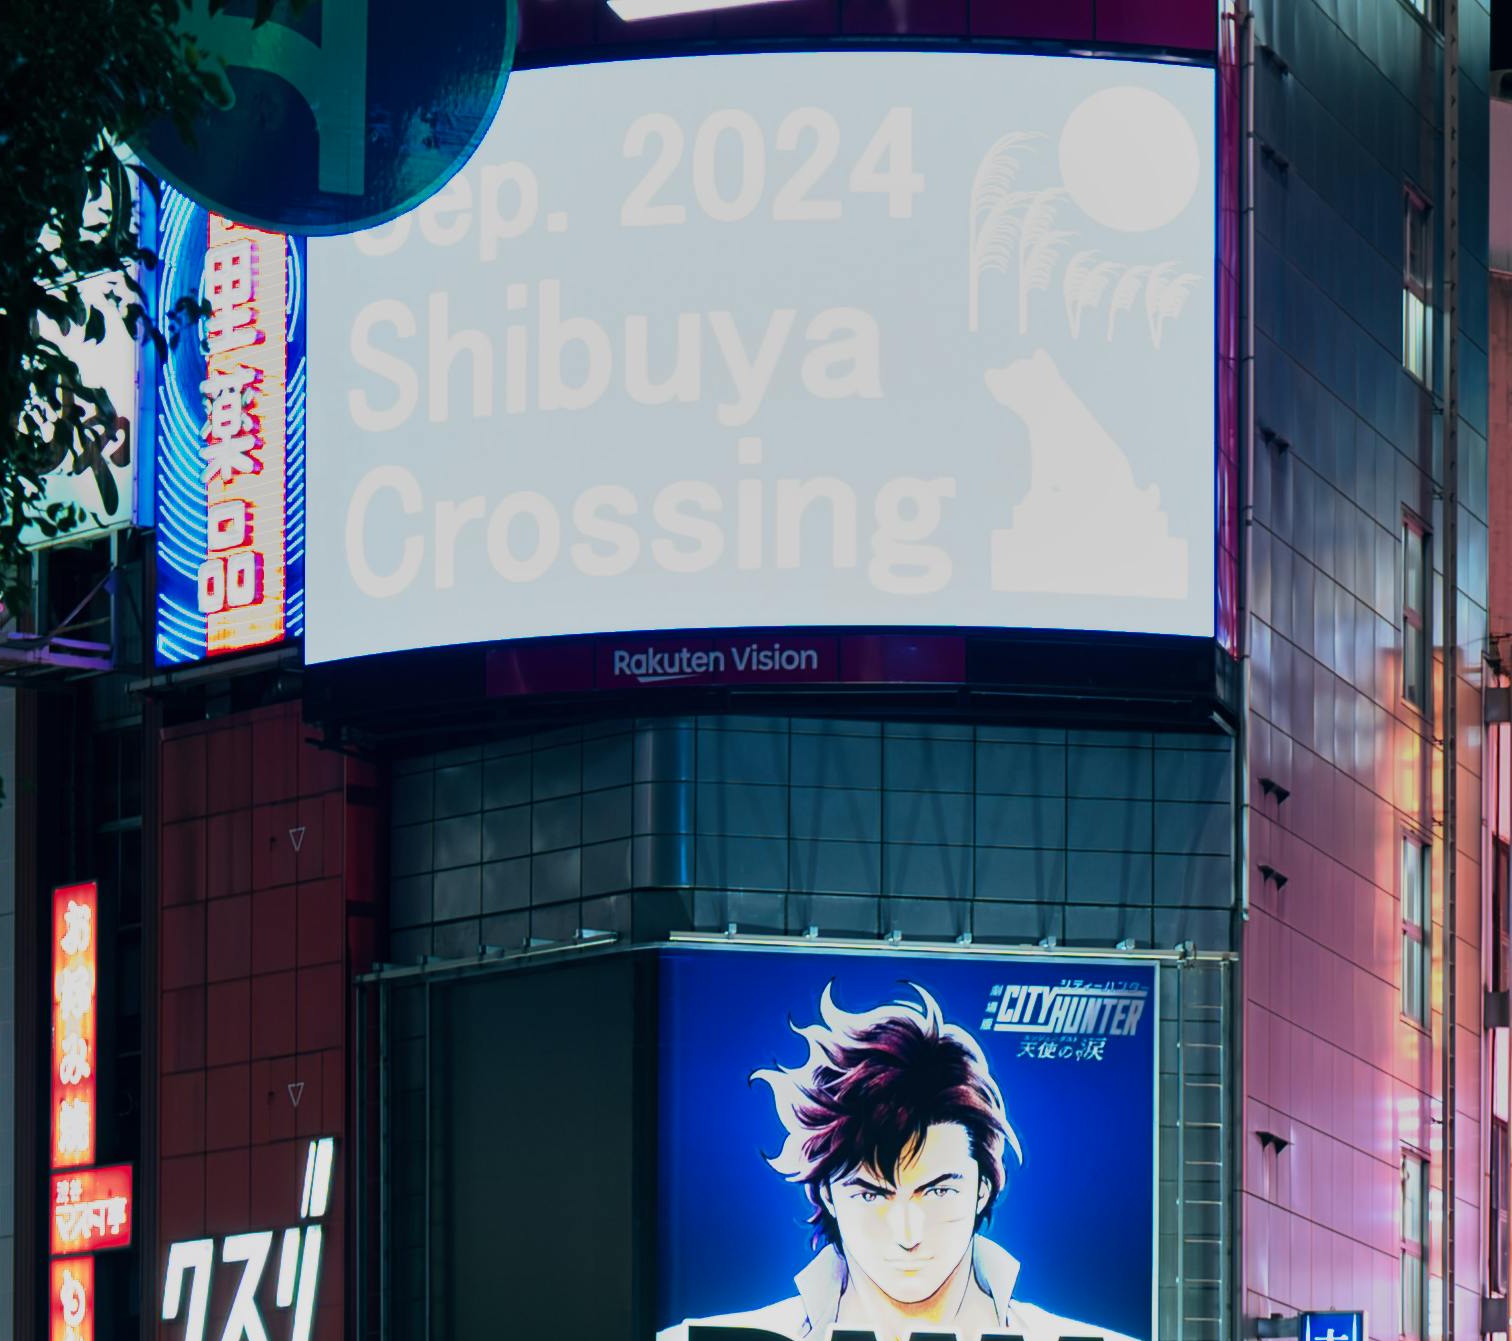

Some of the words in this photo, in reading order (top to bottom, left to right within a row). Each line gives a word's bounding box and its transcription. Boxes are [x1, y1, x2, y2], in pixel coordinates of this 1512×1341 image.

[352, 161, 568, 261] ep.
[620, 106, 924, 227] 2024
[196, 236, 267, 615] 里薬品
[347, 280, 884, 432] Shibuya
[344, 436, 956, 599] Crossing
[614, 648, 725, 682] Rakuten
[731, 643, 818, 671] Vision
[996, 985, 1055, 1024] CITY
[1048, 995, 1146, 1036] HUNTER
